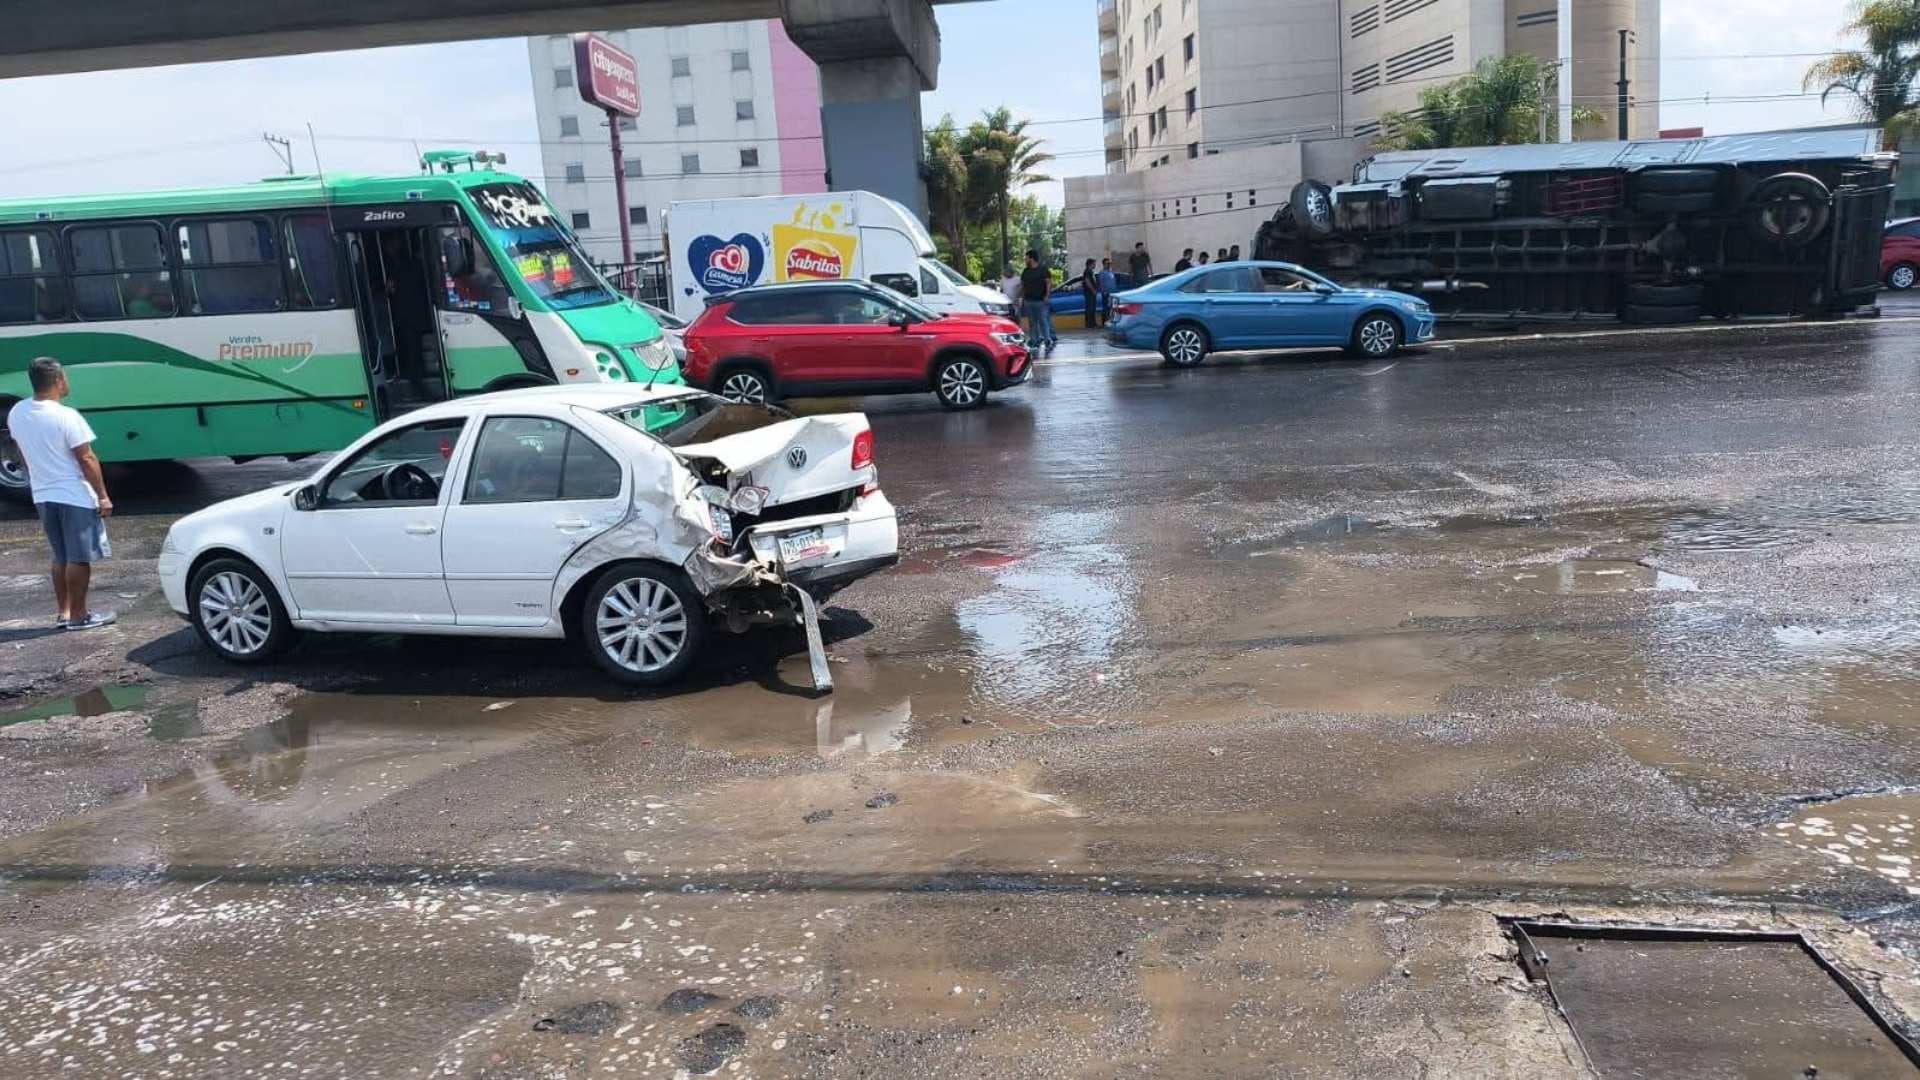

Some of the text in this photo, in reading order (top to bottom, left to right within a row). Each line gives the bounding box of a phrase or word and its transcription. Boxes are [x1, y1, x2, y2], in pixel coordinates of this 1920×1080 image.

[363, 211, 405, 221] Zafiro
[787, 251, 841, 275] Sabritas
[228, 335, 262, 344] Verdes
[219, 341, 313, 360] Premium
